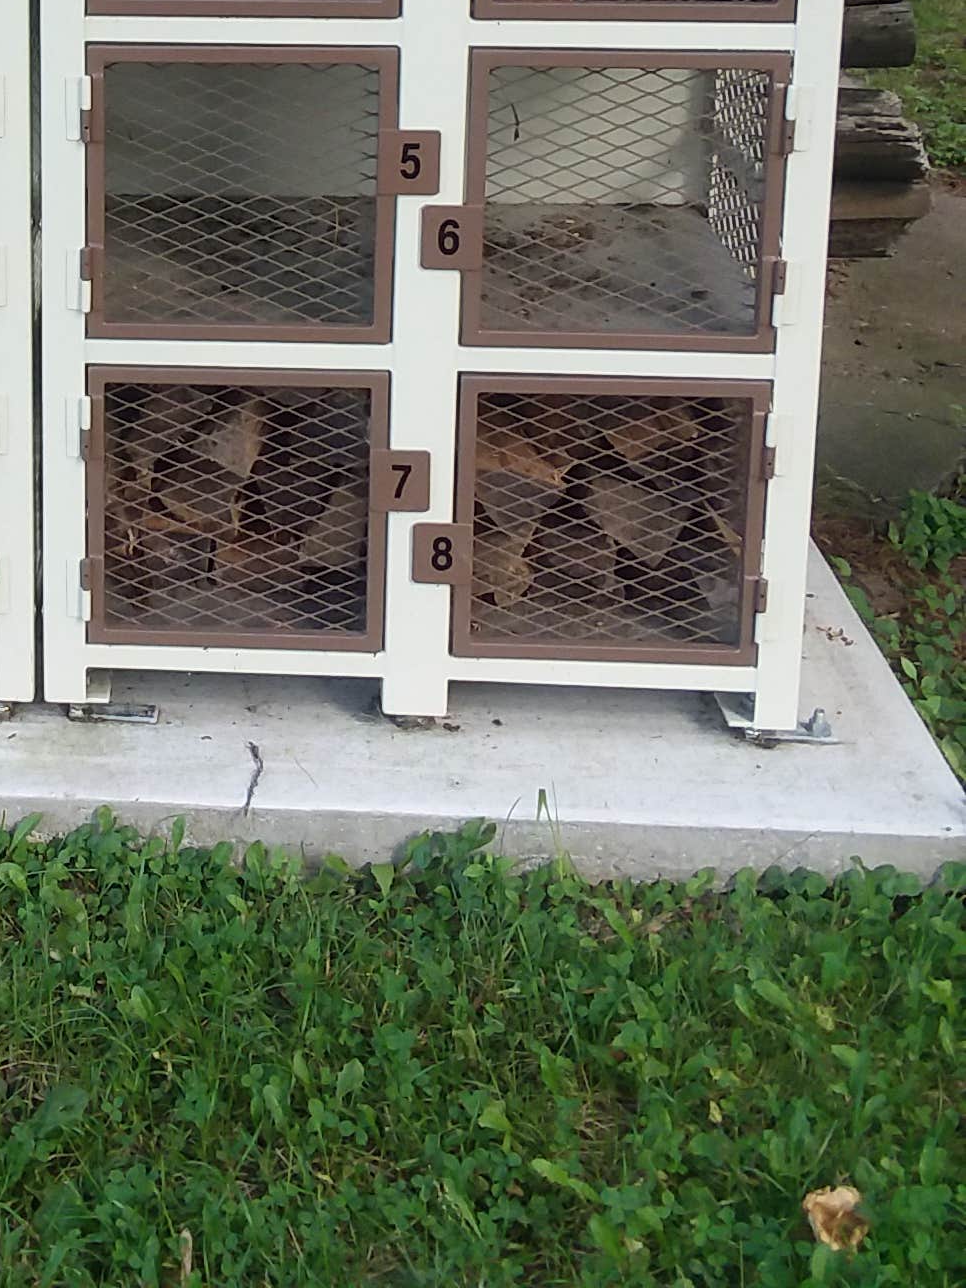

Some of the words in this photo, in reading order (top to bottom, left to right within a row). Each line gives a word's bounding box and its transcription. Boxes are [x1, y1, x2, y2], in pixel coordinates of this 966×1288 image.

[400, 143, 421, 179] 5
[438, 219, 460, 255] 6
[391, 465, 412, 499] 7
[431, 536, 453, 571] 8
